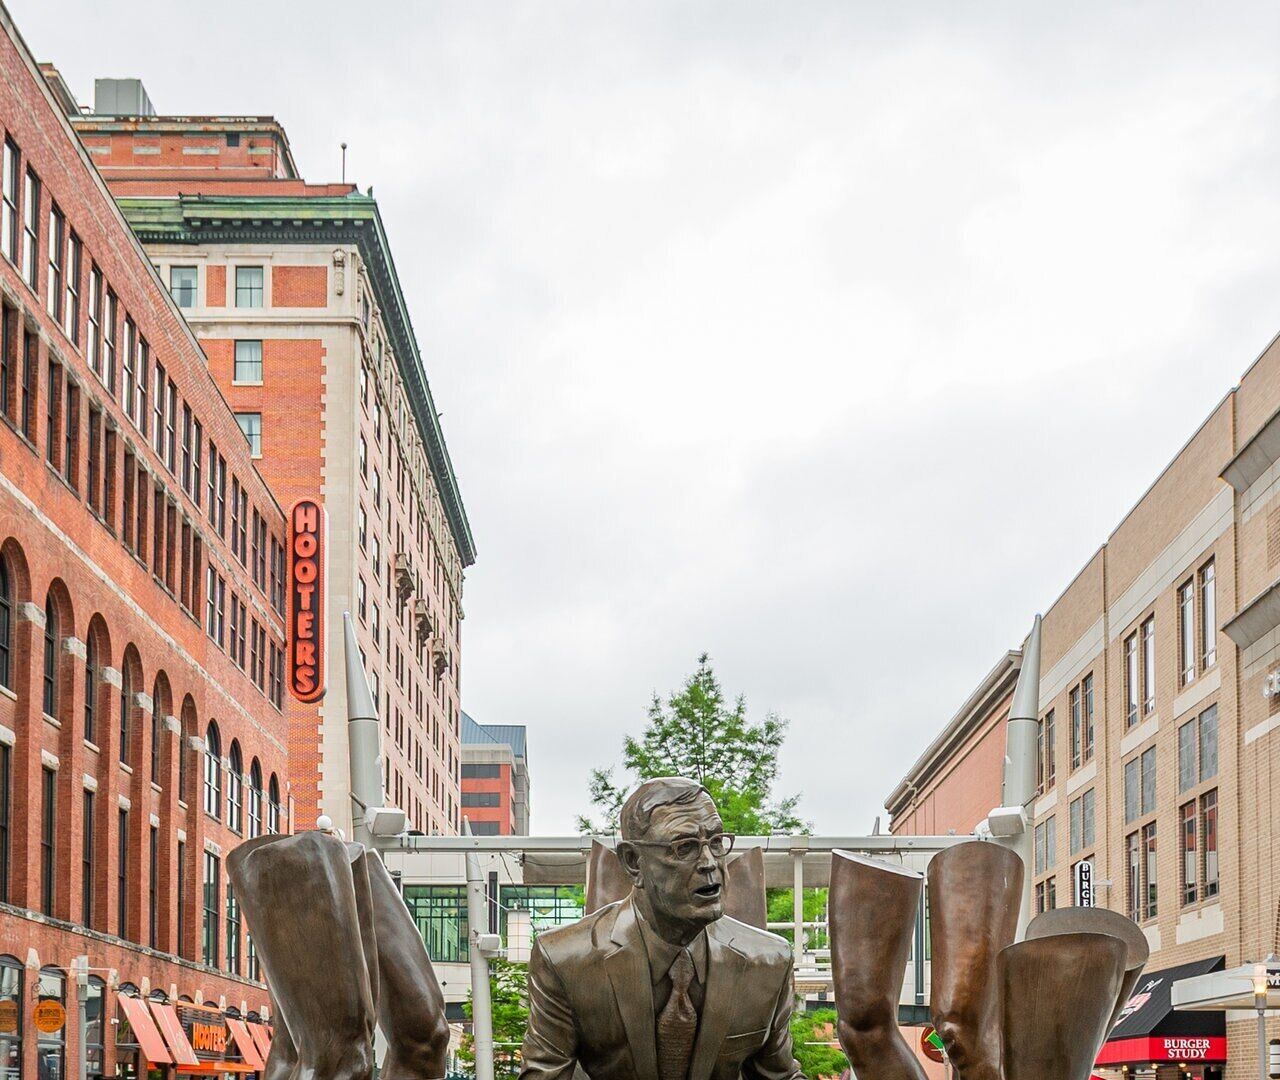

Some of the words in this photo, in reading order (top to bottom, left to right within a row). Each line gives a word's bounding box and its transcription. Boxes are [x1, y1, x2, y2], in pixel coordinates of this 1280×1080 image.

[294, 506, 317, 693] HOOTERS
[193, 1022, 226, 1052] HOOTERS
[1164, 1039, 1210, 1049] BURGER
[1168, 1049, 1207, 1058] STUDY
